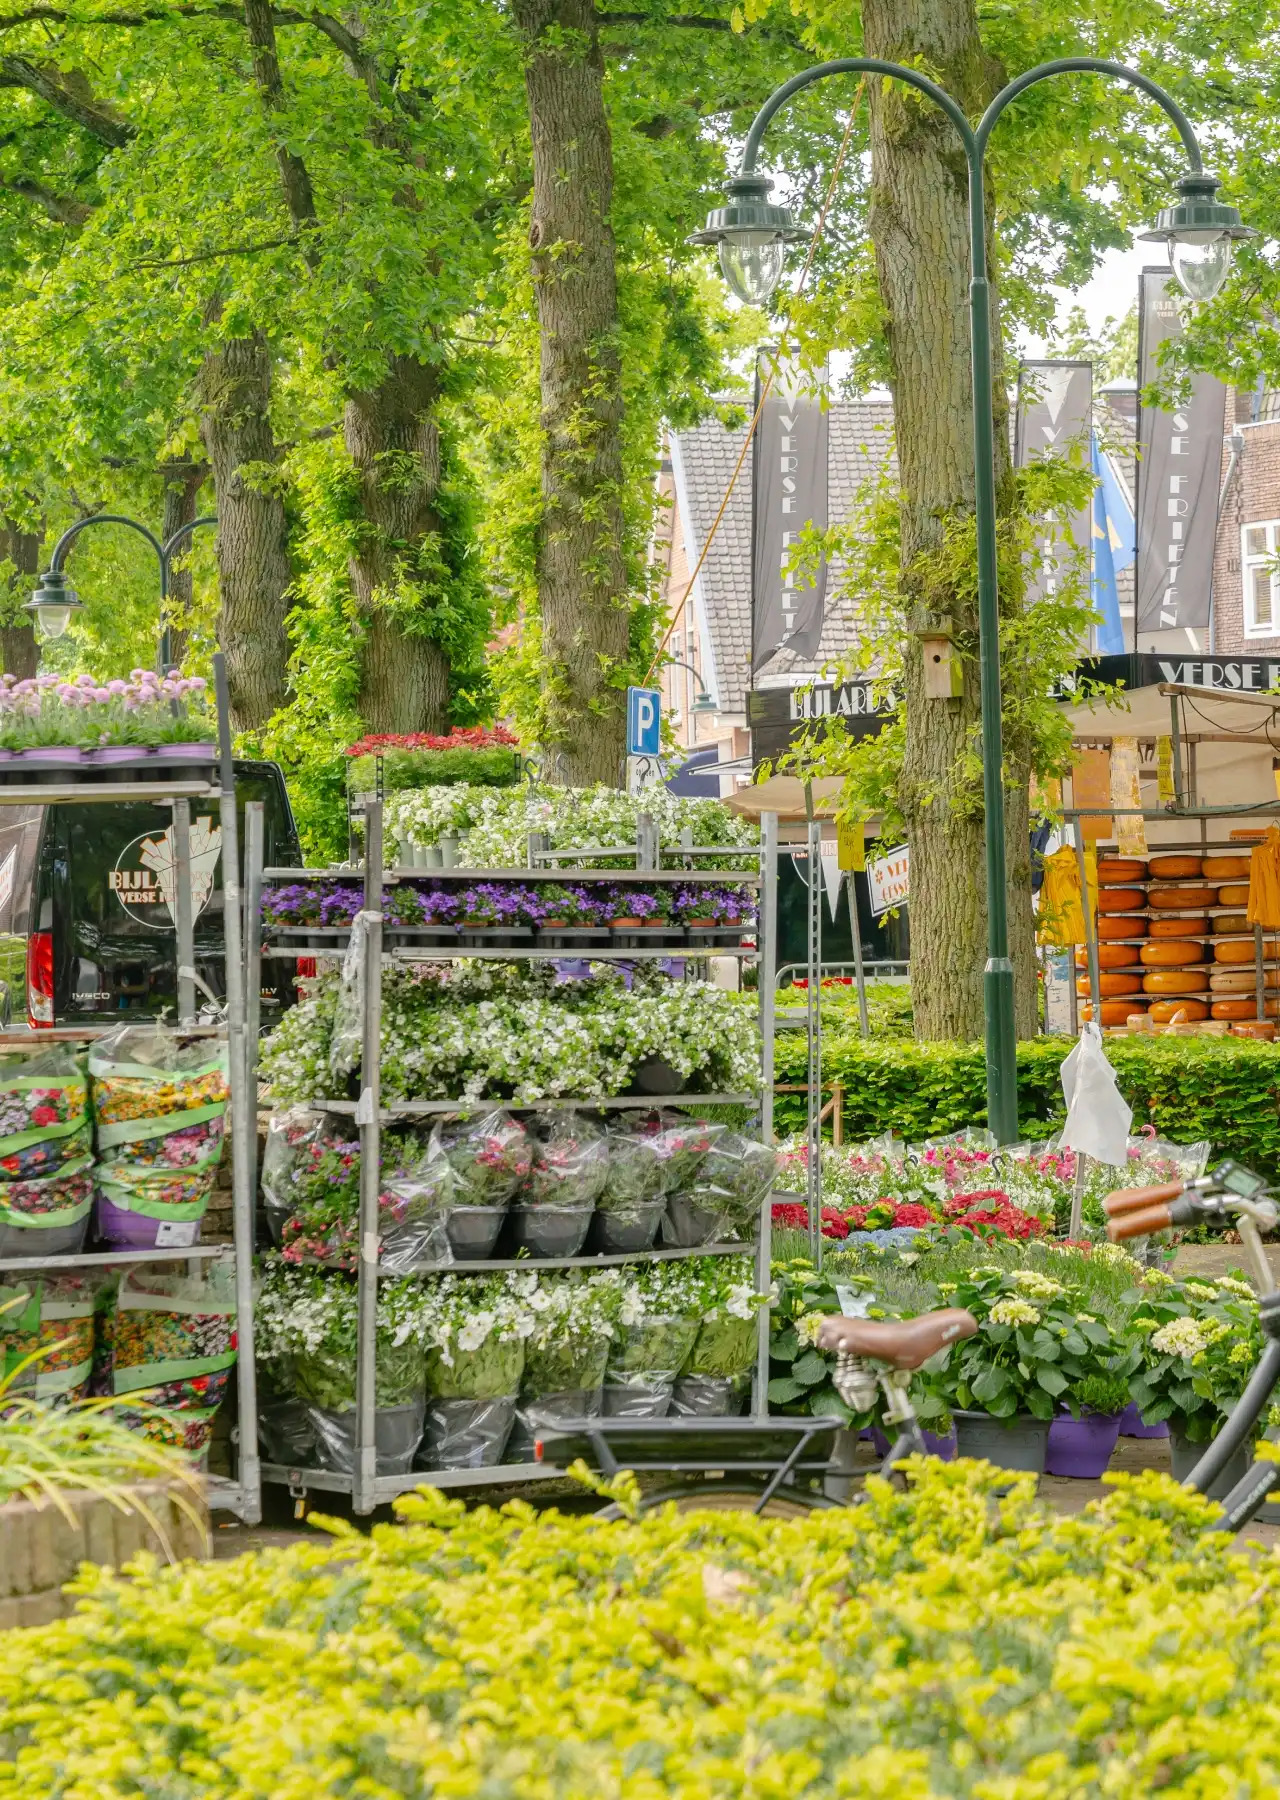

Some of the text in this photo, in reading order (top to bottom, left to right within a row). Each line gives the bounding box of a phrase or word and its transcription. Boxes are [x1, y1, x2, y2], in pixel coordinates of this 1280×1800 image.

[778, 415, 799, 514] VERSE
[1159, 475, 1189, 629] FRIETEN
[1158, 661, 1262, 690] VERSE
[637, 697, 654, 747] P
[71, 992, 111, 1000] IVECO
